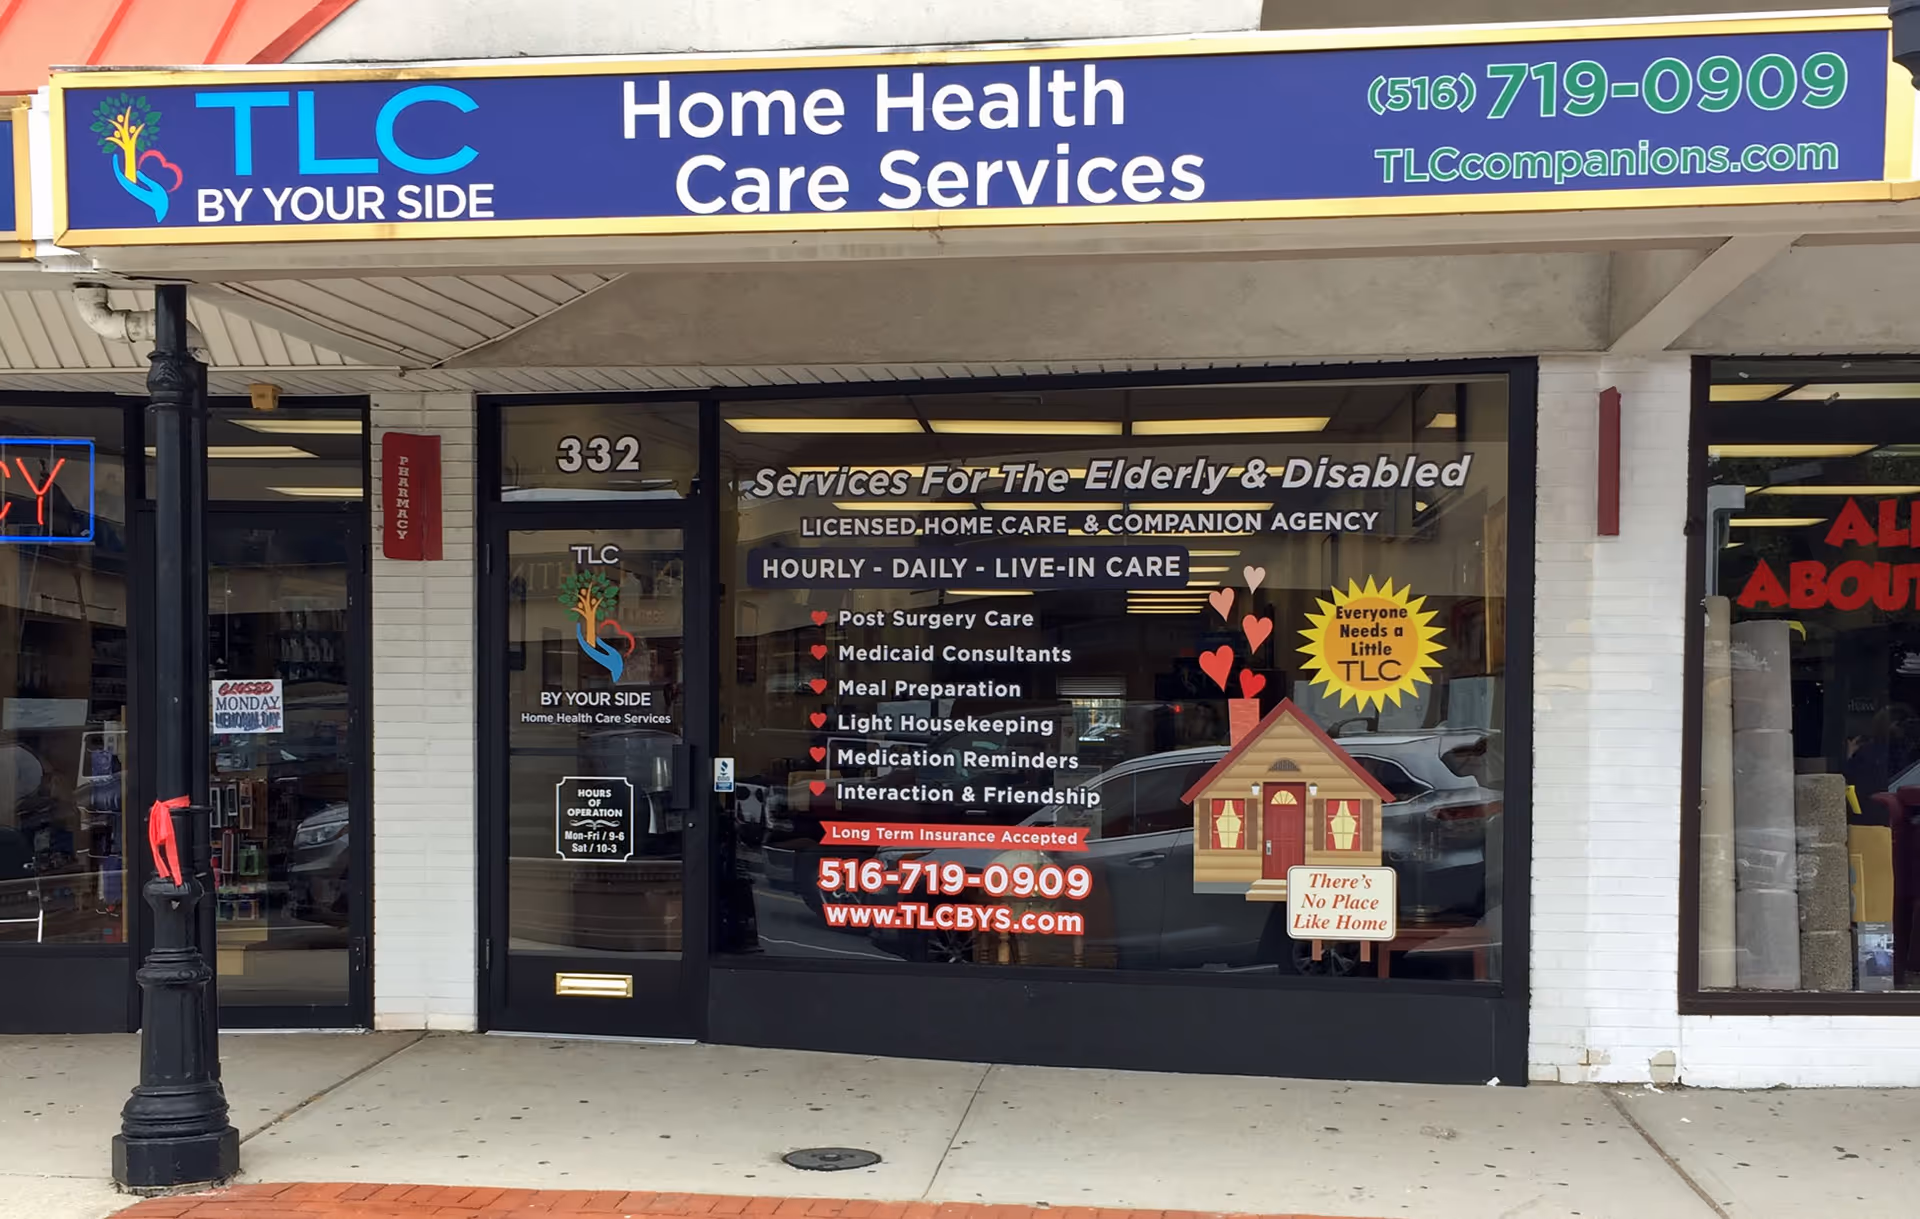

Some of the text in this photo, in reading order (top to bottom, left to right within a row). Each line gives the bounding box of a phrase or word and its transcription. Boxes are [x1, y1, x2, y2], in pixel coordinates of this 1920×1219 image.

[1367, 51, 1848, 119] (516) 719-0909
[623, 63, 1125, 139] Home Health
[195, 85, 479, 175] TLC
[1374, 139, 1839, 184] TLCcompanions.com
[676, 143, 1206, 214] Care Services
[197, 183, 495, 222] BY YOUR SIDE
[557, 436, 640, 473] 332
[752, 454, 1473, 497] Services For The Elderly & Disabled
[0, 458, 66, 526] Y
[396, 456, 409, 540] PHARMACY
[802, 511, 1379, 537] LICENSED HOME CARE & COMPANION AGENCY
[571, 545, 619, 564] TLC
[763, 558, 866, 578] HOURLY
[892, 558, 968, 578] DAILY
[995, 557, 1095, 578] LIVE-IN
[1106, 556, 1181, 577] CARE
[839, 611, 1034, 629] Post Surgery Care
[1336, 606, 1408, 622] Everyone
[1340, 622, 1403, 638] Needs a
[838, 645, 1072, 663] Medicaid Consultants
[1351, 641, 1392, 656] Little
[1337, 659, 1402, 681] TLC
[541, 692, 651, 706] BY YOUR SIDE
[838, 680, 1021, 699] Meal Preparation
[215, 696, 280, 710] MONDAY
[521, 713, 671, 724] Home Health Care Services
[837, 714, 1054, 736] Light Housekeeping
[837, 749, 1079, 769] Medication Reminders
[578, 789, 612, 798] HOURS
[588, 799, 601, 807] OF
[837, 784, 1100, 808] Interaction & Friendship
[567, 808, 623, 817] OPERATION
[565, 831, 600, 841] Mon-Fri
[609, 831, 625, 841] 9-6
[832, 826, 1078, 846] Long Term Insurance Accepted
[572, 843, 587, 853] Sat
[596, 844, 617, 853] 10-3
[820, 860, 1090, 897] 516-719-0909
[1301, 893, 1379, 910] No Place
[826, 905, 1082, 932] www.TLCBYS.com
[1293, 914, 1387, 931] Like Home
